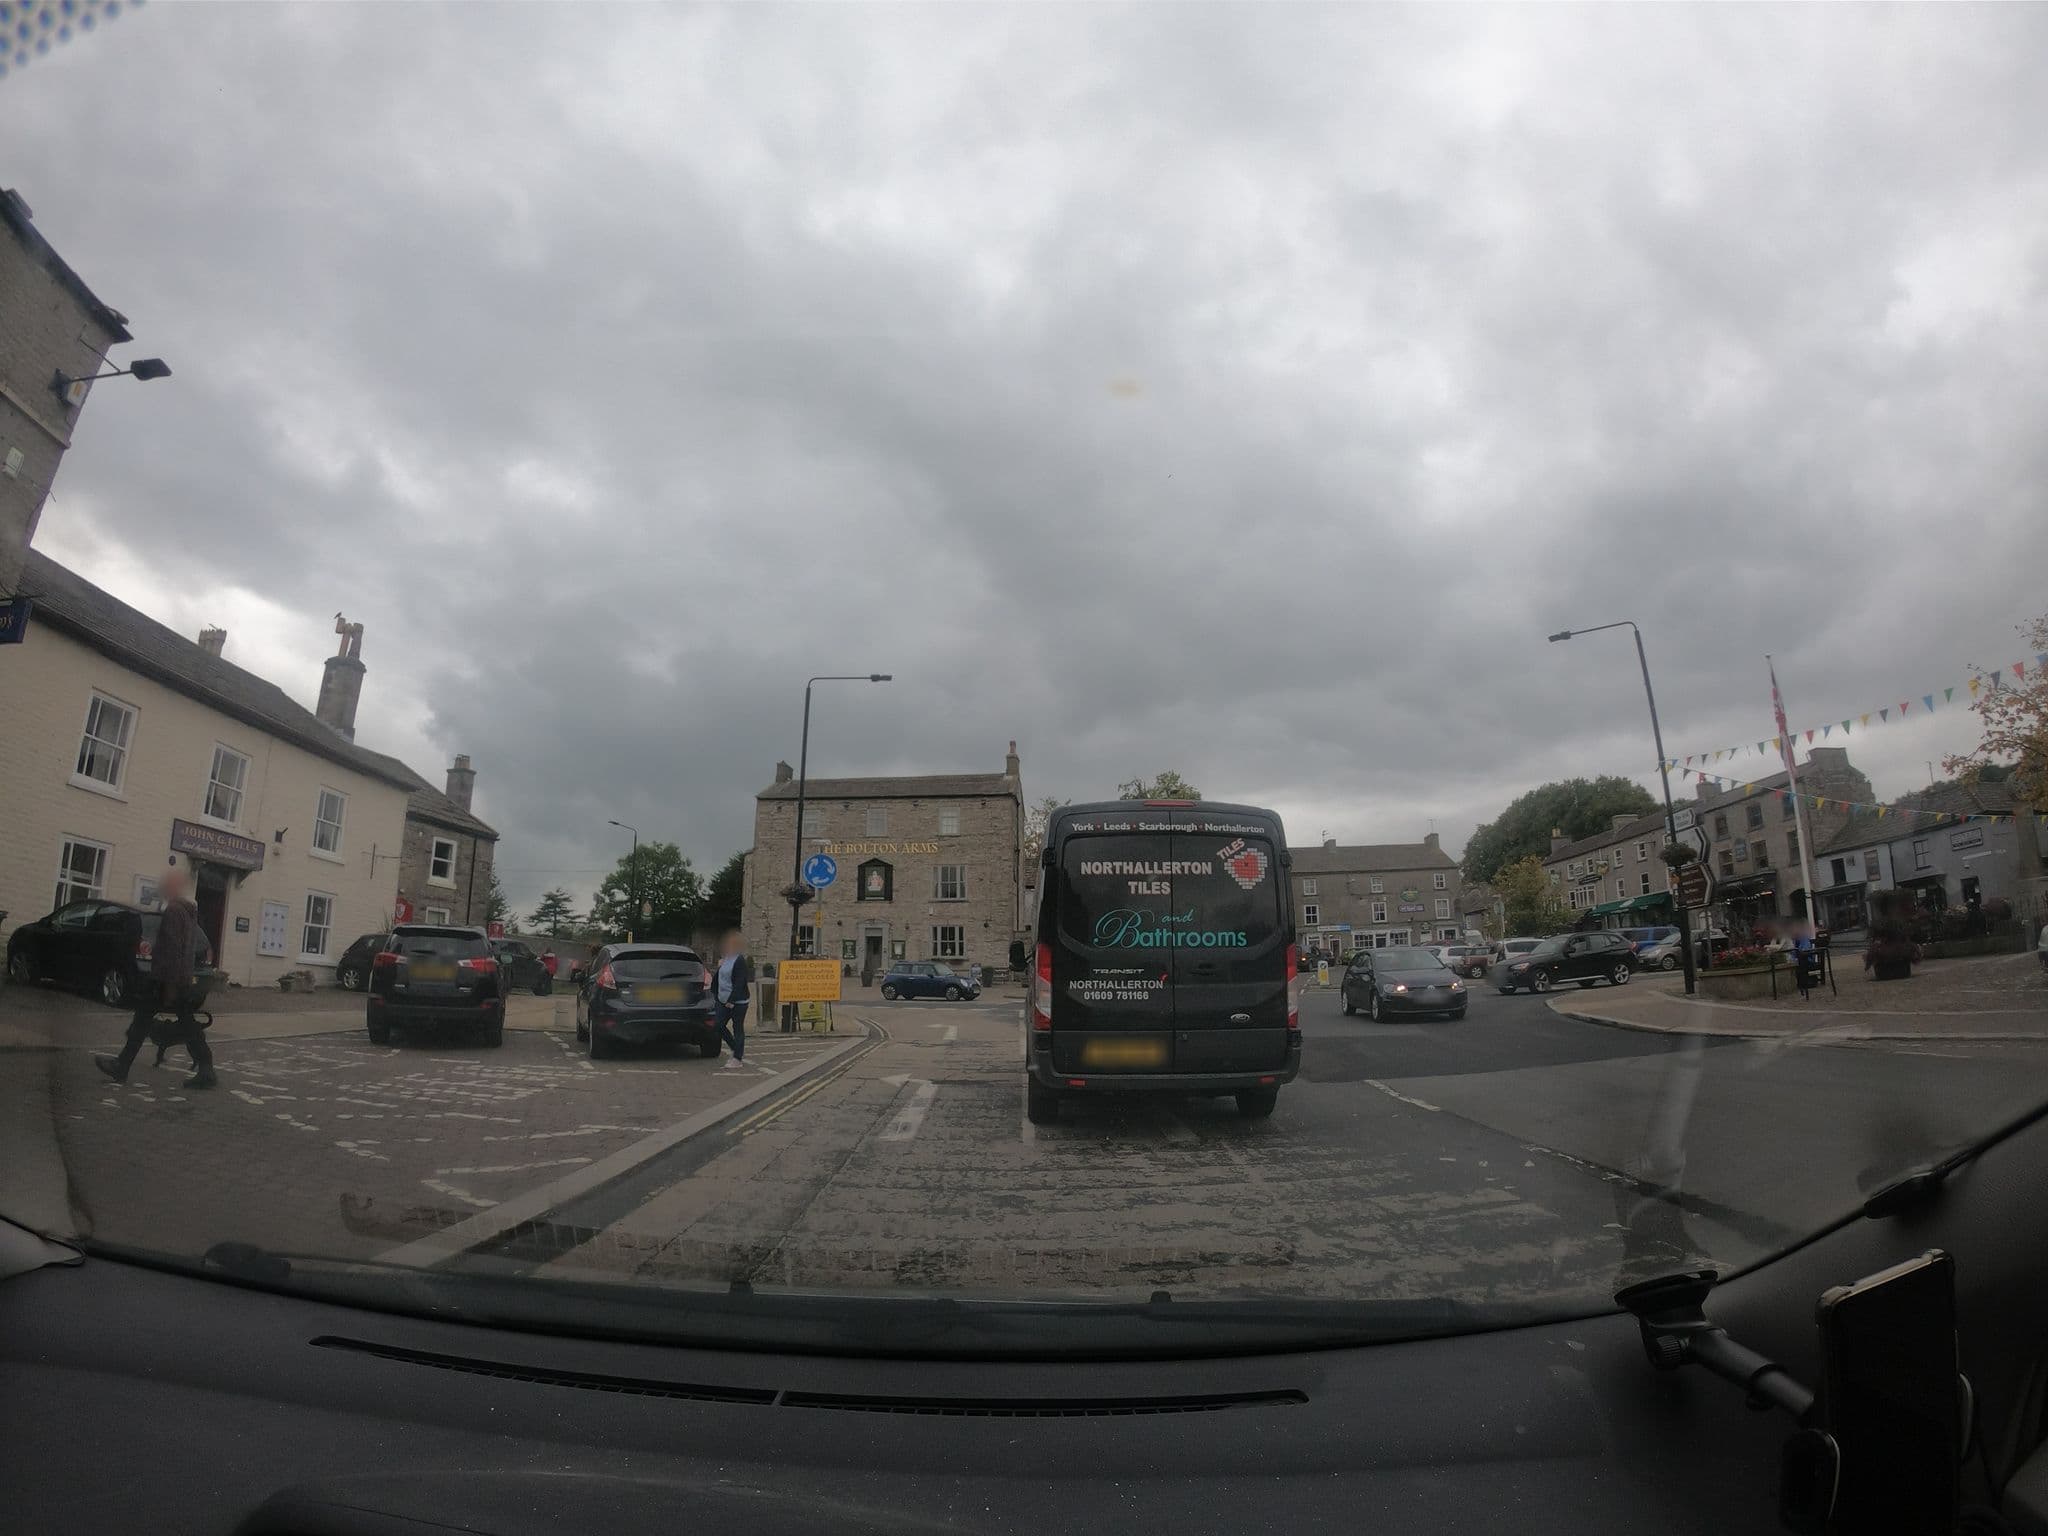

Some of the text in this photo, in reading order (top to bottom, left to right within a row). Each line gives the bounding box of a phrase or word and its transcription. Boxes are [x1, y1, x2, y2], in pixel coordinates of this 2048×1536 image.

[183, 827, 214, 842] JOHN
[1072, 822, 1265, 834] York Leeds Scarborough Northallerton
[846, 843, 898, 854] BOLTON
[902, 842, 938, 854] ARMS
[1216, 837, 1246, 861] TILES
[1080, 861, 1213, 875] NORTHALLERTON
[1127, 881, 1171, 895] TILES
[1161, 908, 1194, 923] and
[1092, 908, 1247, 949] Bathrooms
[1069, 980, 1164, 989] NORTHALLERTON
[1083, 991, 1149, 1000] 01609 781166
